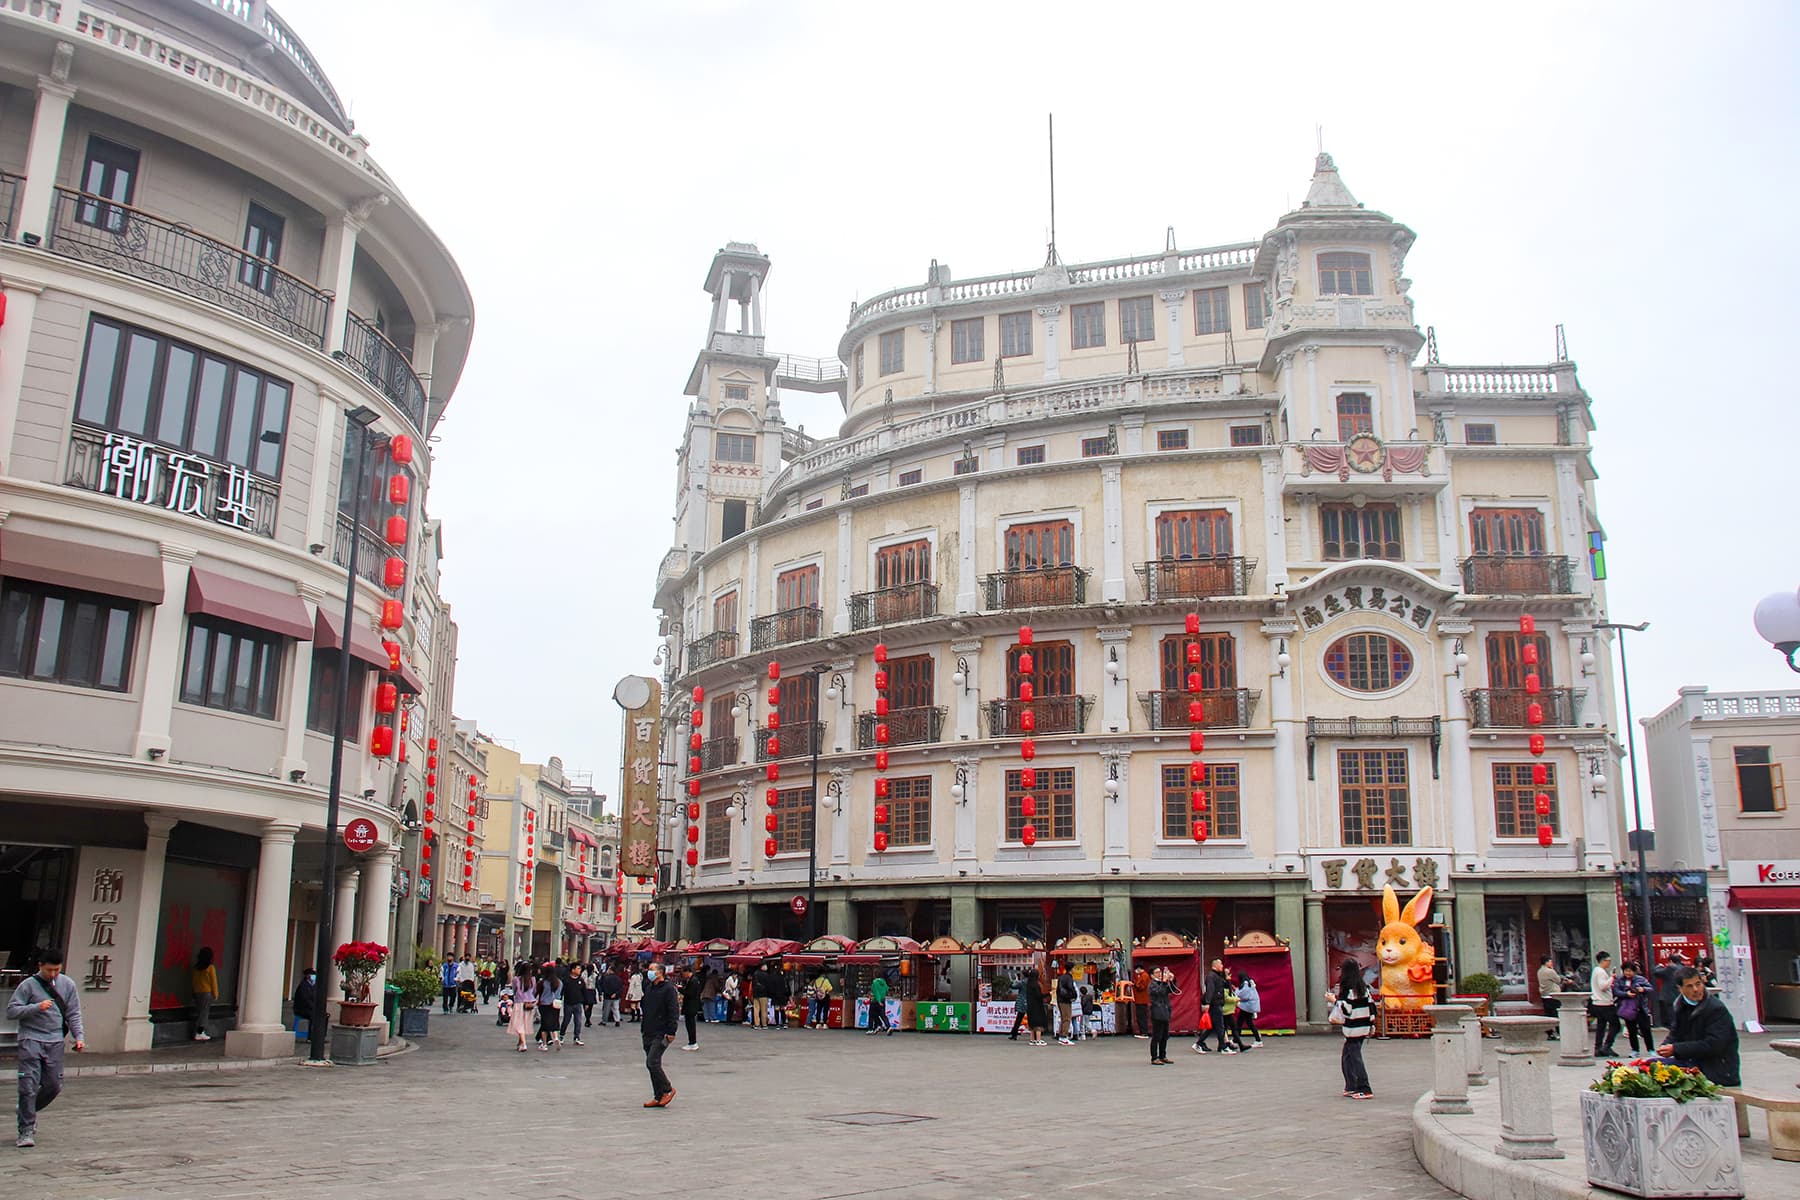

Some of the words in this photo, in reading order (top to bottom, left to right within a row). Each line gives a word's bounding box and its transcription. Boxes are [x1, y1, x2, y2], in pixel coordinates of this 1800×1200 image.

[100, 433, 255, 531] 潮宏基
[628, 717, 656, 866] 百貨大樓
[1321, 857, 1441, 890] 百貨大樓
[84, 868, 125, 992] 潮宏基
